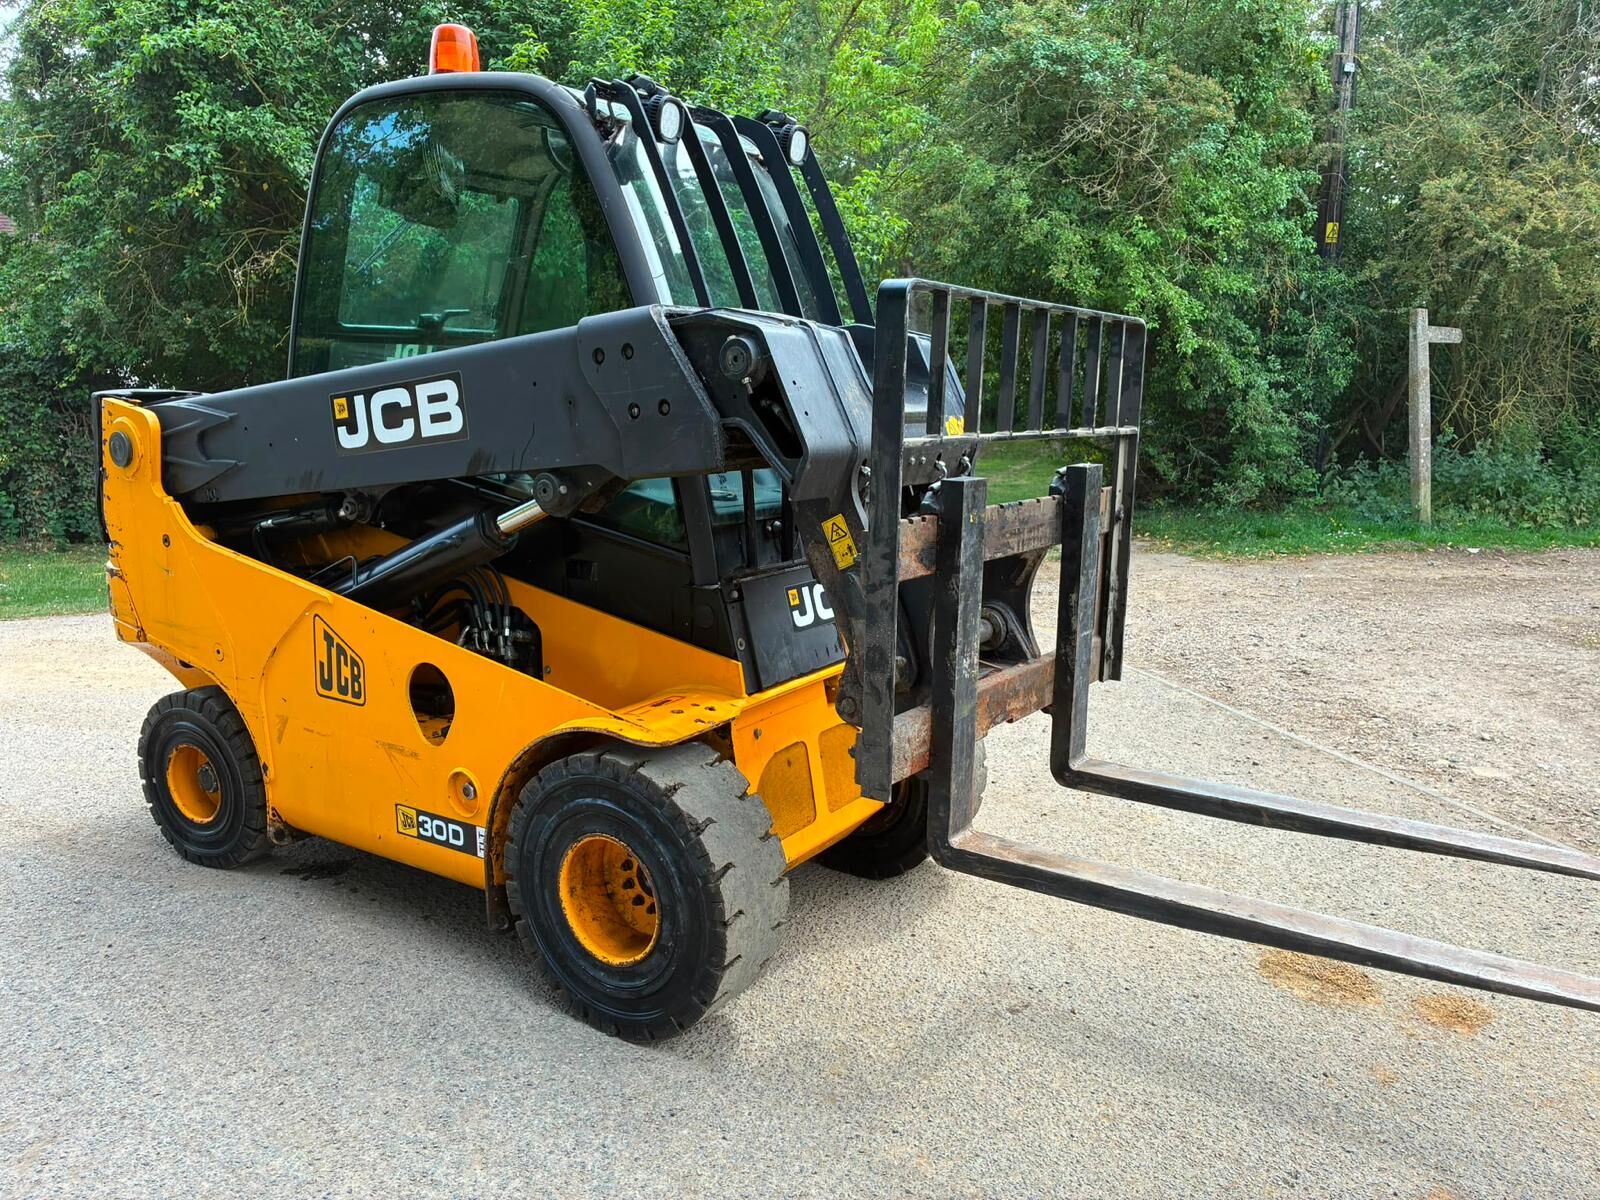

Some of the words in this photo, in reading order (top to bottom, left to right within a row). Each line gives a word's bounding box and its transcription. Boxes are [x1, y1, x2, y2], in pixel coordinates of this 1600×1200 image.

[337, 379, 464, 449] JCB
[792, 583, 835, 627] JC
[319, 627, 362, 700] JCB
[418, 815, 464, 847] 30D
